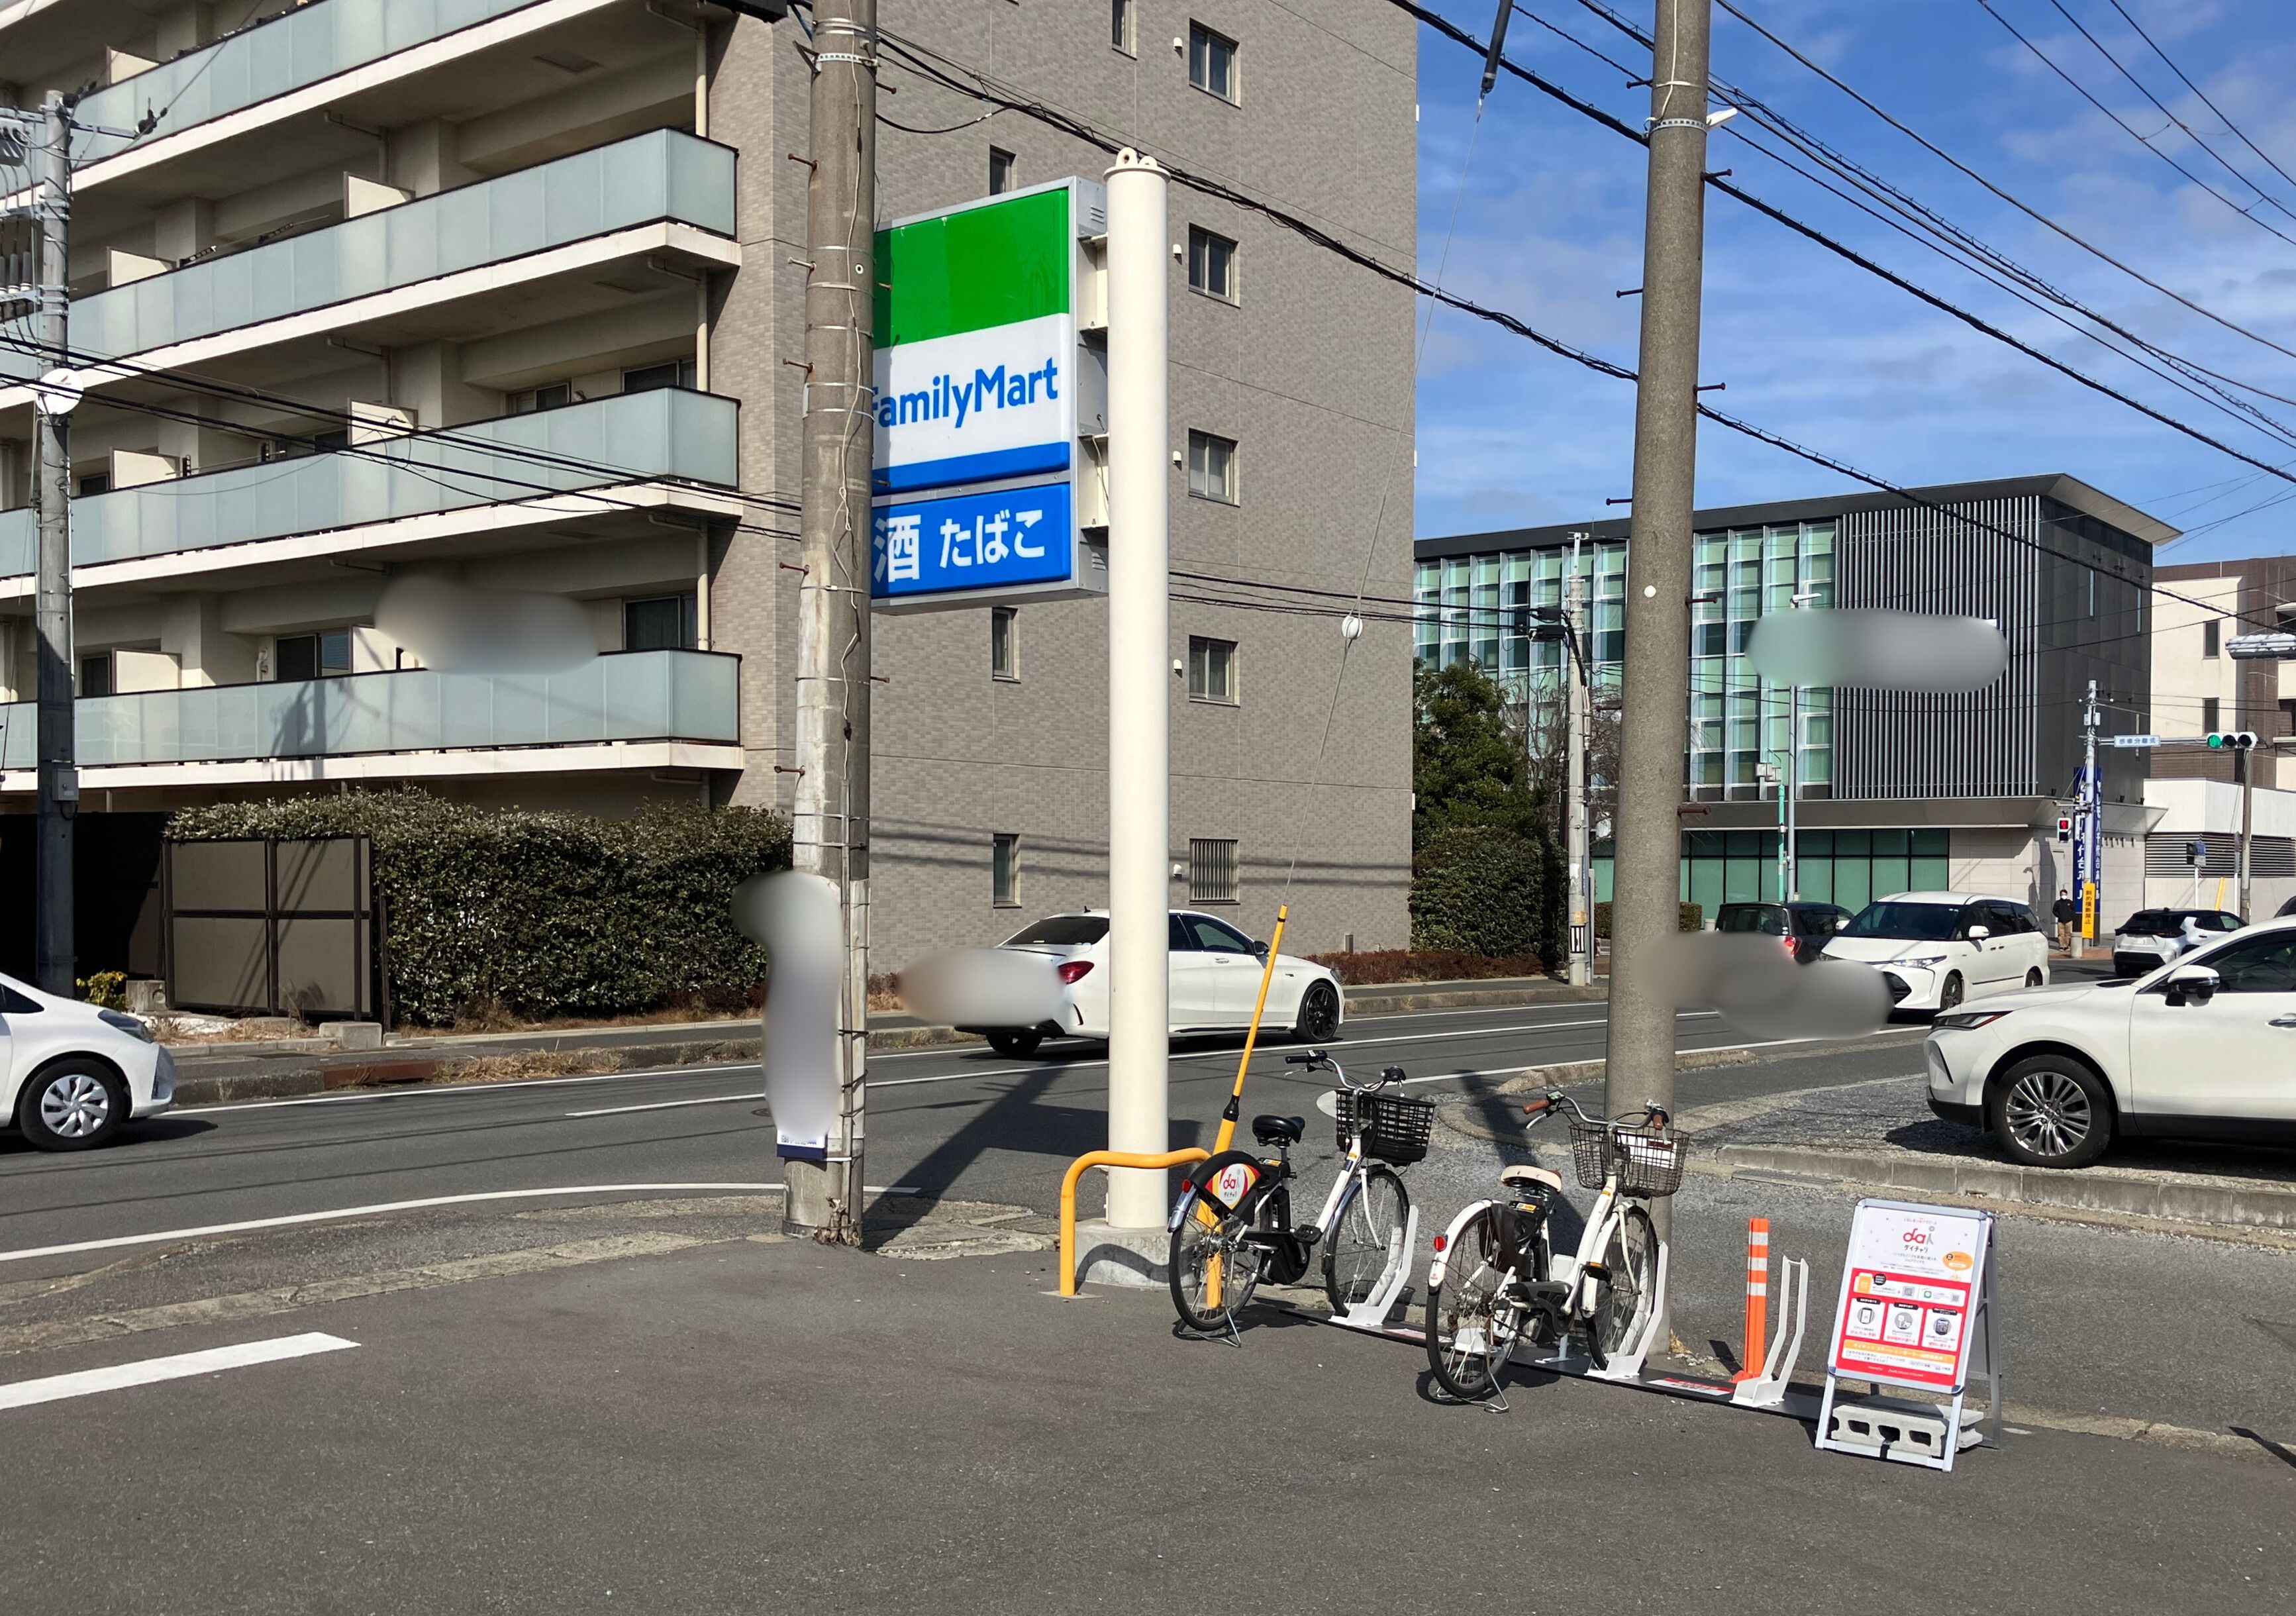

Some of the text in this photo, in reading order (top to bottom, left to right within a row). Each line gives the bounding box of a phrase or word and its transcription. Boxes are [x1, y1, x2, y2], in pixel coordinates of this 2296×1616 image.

[873, 509, 1045, 583] 酒 たばこ
[1904, 1244, 1928, 1253] ダイチャリ
